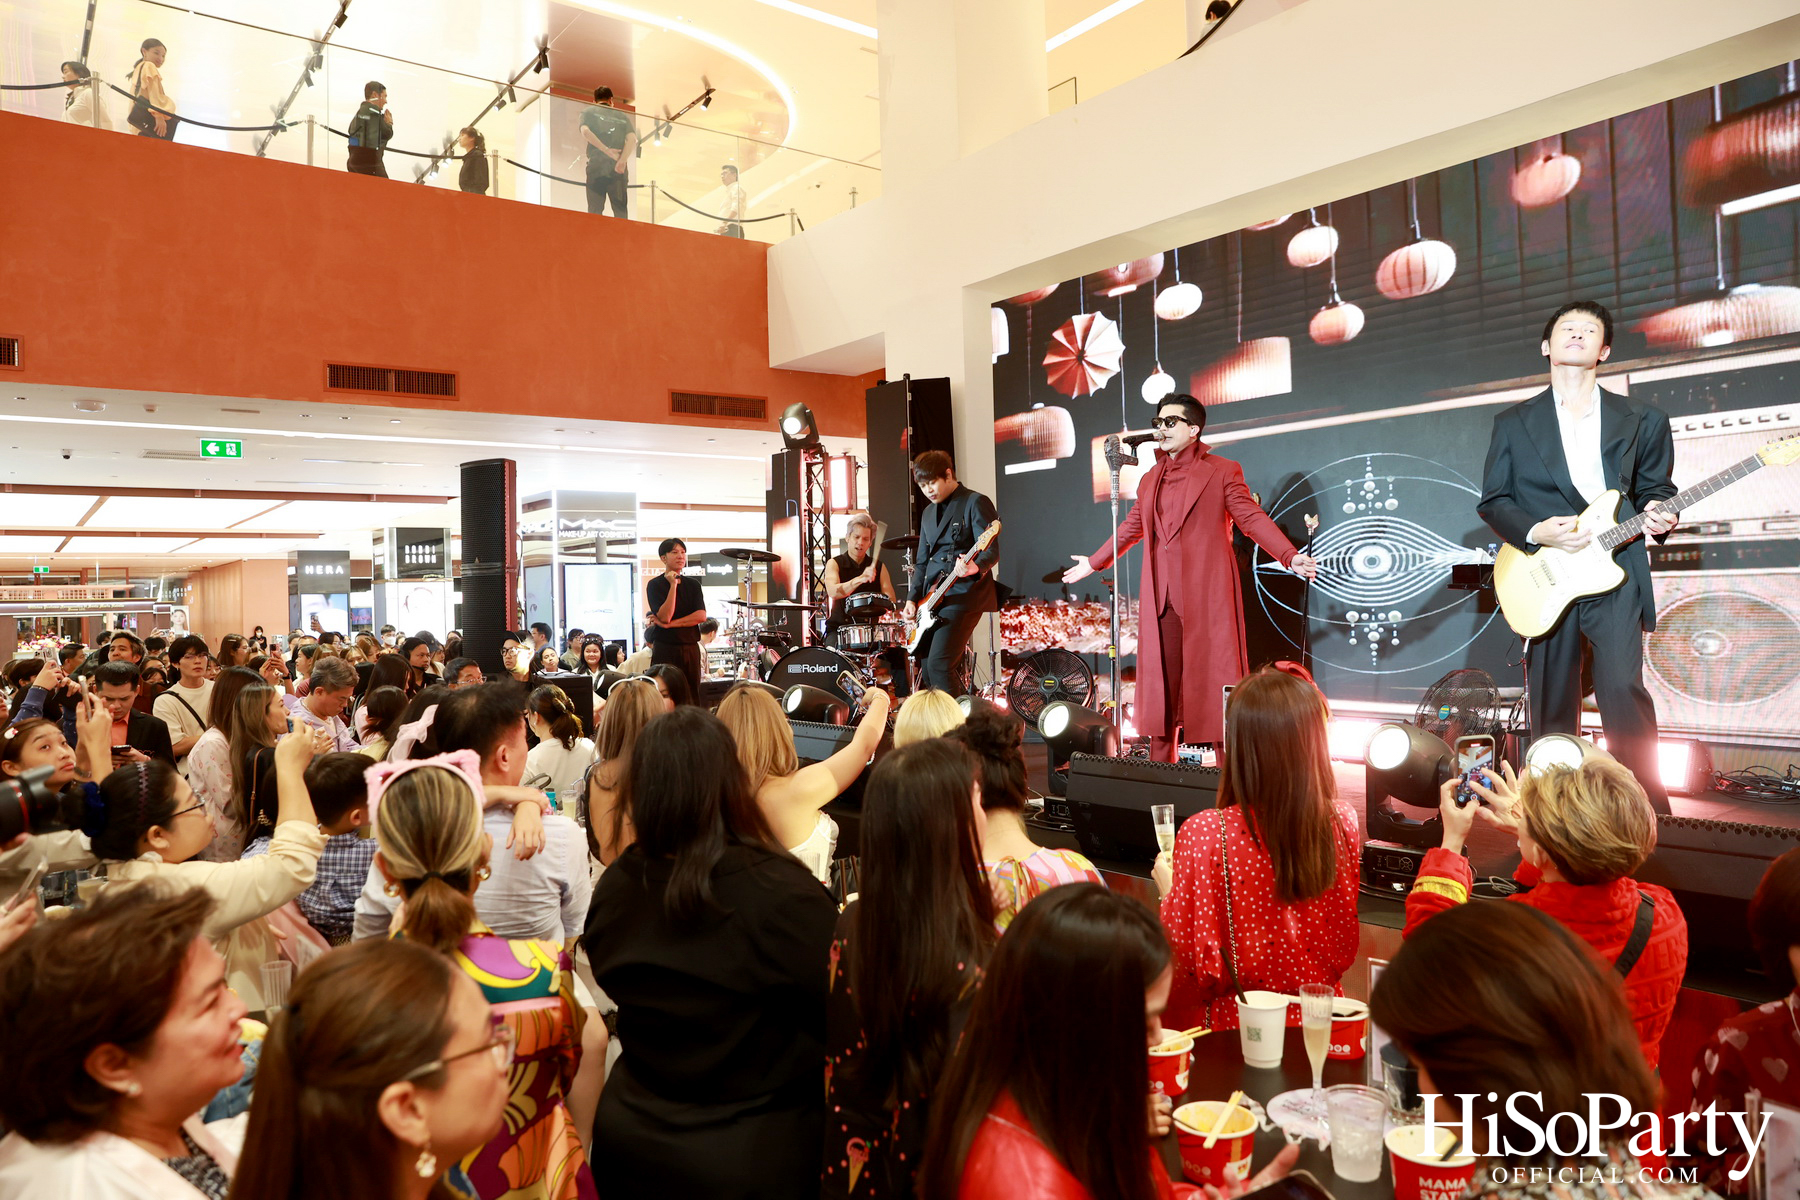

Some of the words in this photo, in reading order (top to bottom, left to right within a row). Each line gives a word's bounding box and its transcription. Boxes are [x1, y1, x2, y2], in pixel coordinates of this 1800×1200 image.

[405, 545, 435, 554] BOBBI
[405, 555, 436, 564] BROWN
[305, 565, 344, 575] HERA
[802, 663, 838, 673] Roland
[1419, 1176, 1467, 1190] MAMA
[1420, 1189, 1462, 1200] STAT
